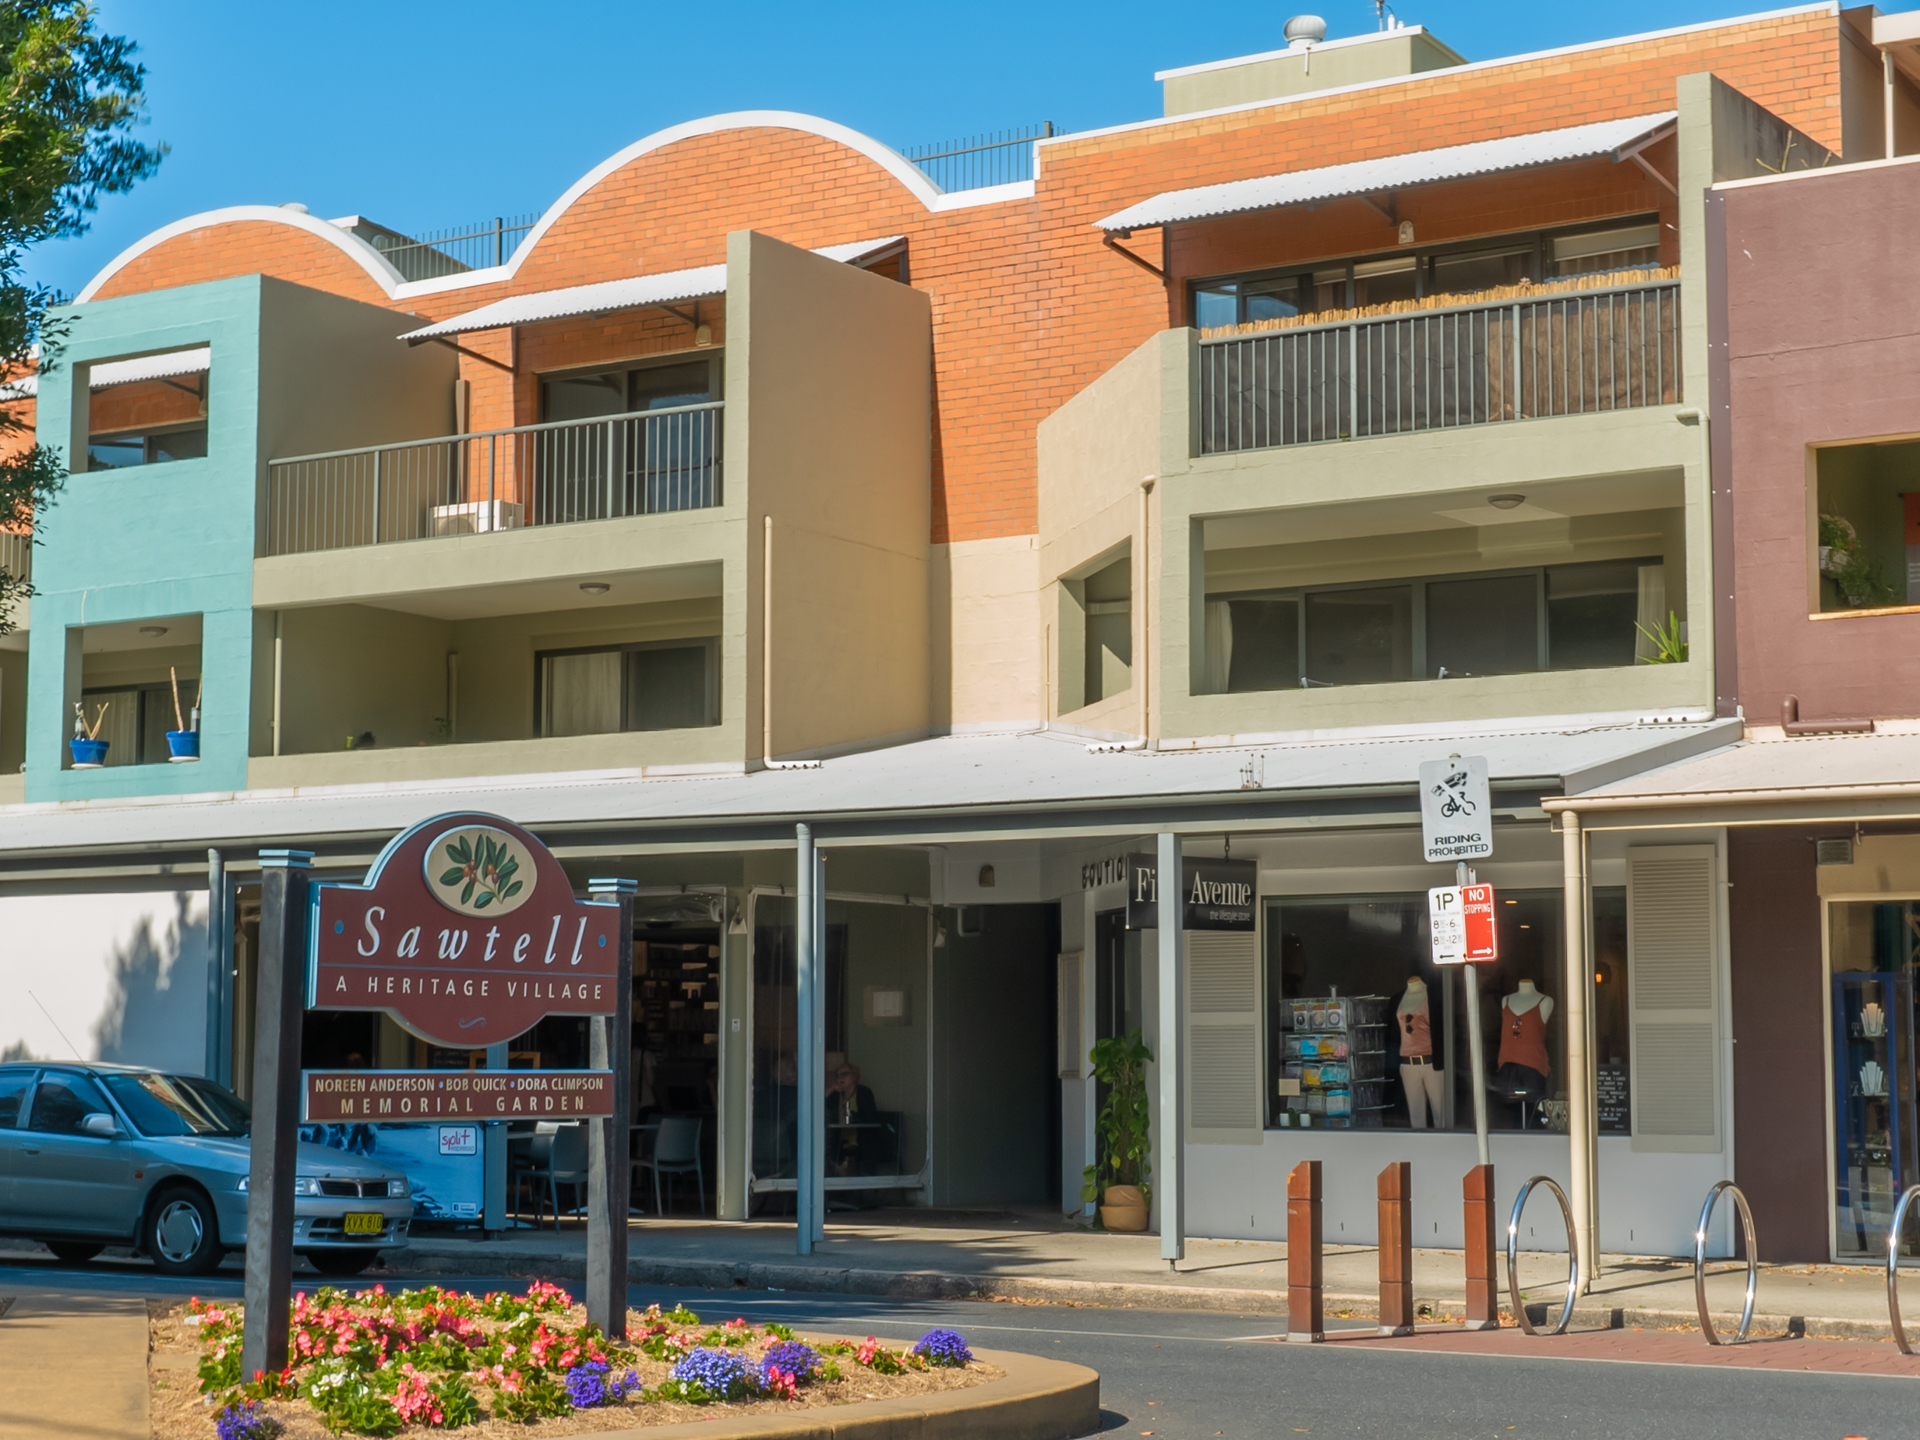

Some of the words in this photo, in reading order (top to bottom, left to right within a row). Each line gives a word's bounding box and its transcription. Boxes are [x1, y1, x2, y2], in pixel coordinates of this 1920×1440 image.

[1434, 833, 1482, 846] RIDING
[1428, 844, 1489, 857] PROHIBITED
[1082, 857, 1129, 889] BOUTIQ
[1189, 871, 1251, 906] Avenue
[1468, 889, 1485, 901] NO
[1435, 893, 1454, 911] 1P
[1464, 903, 1491, 915] STOPPING
[357, 906, 587, 965] Sawtell
[336, 975, 347, 992] A
[368, 977, 489, 996] HERITAGE
[507, 981, 602, 1000] VILLAGE
[315, 1079, 366, 1092] NOREEN
[370, 1078, 435, 1092] ANDERSON
[446, 1078, 469, 1091] BOB
[472, 1078, 507, 1092] QUICK
[517, 1078, 548, 1091] DORA
[551, 1078, 603, 1090] CLIMPSON
[341, 1097, 473, 1114] MEMORIAL
[496, 1096, 584, 1111] GARDEN
[441, 1129, 470, 1150] split
